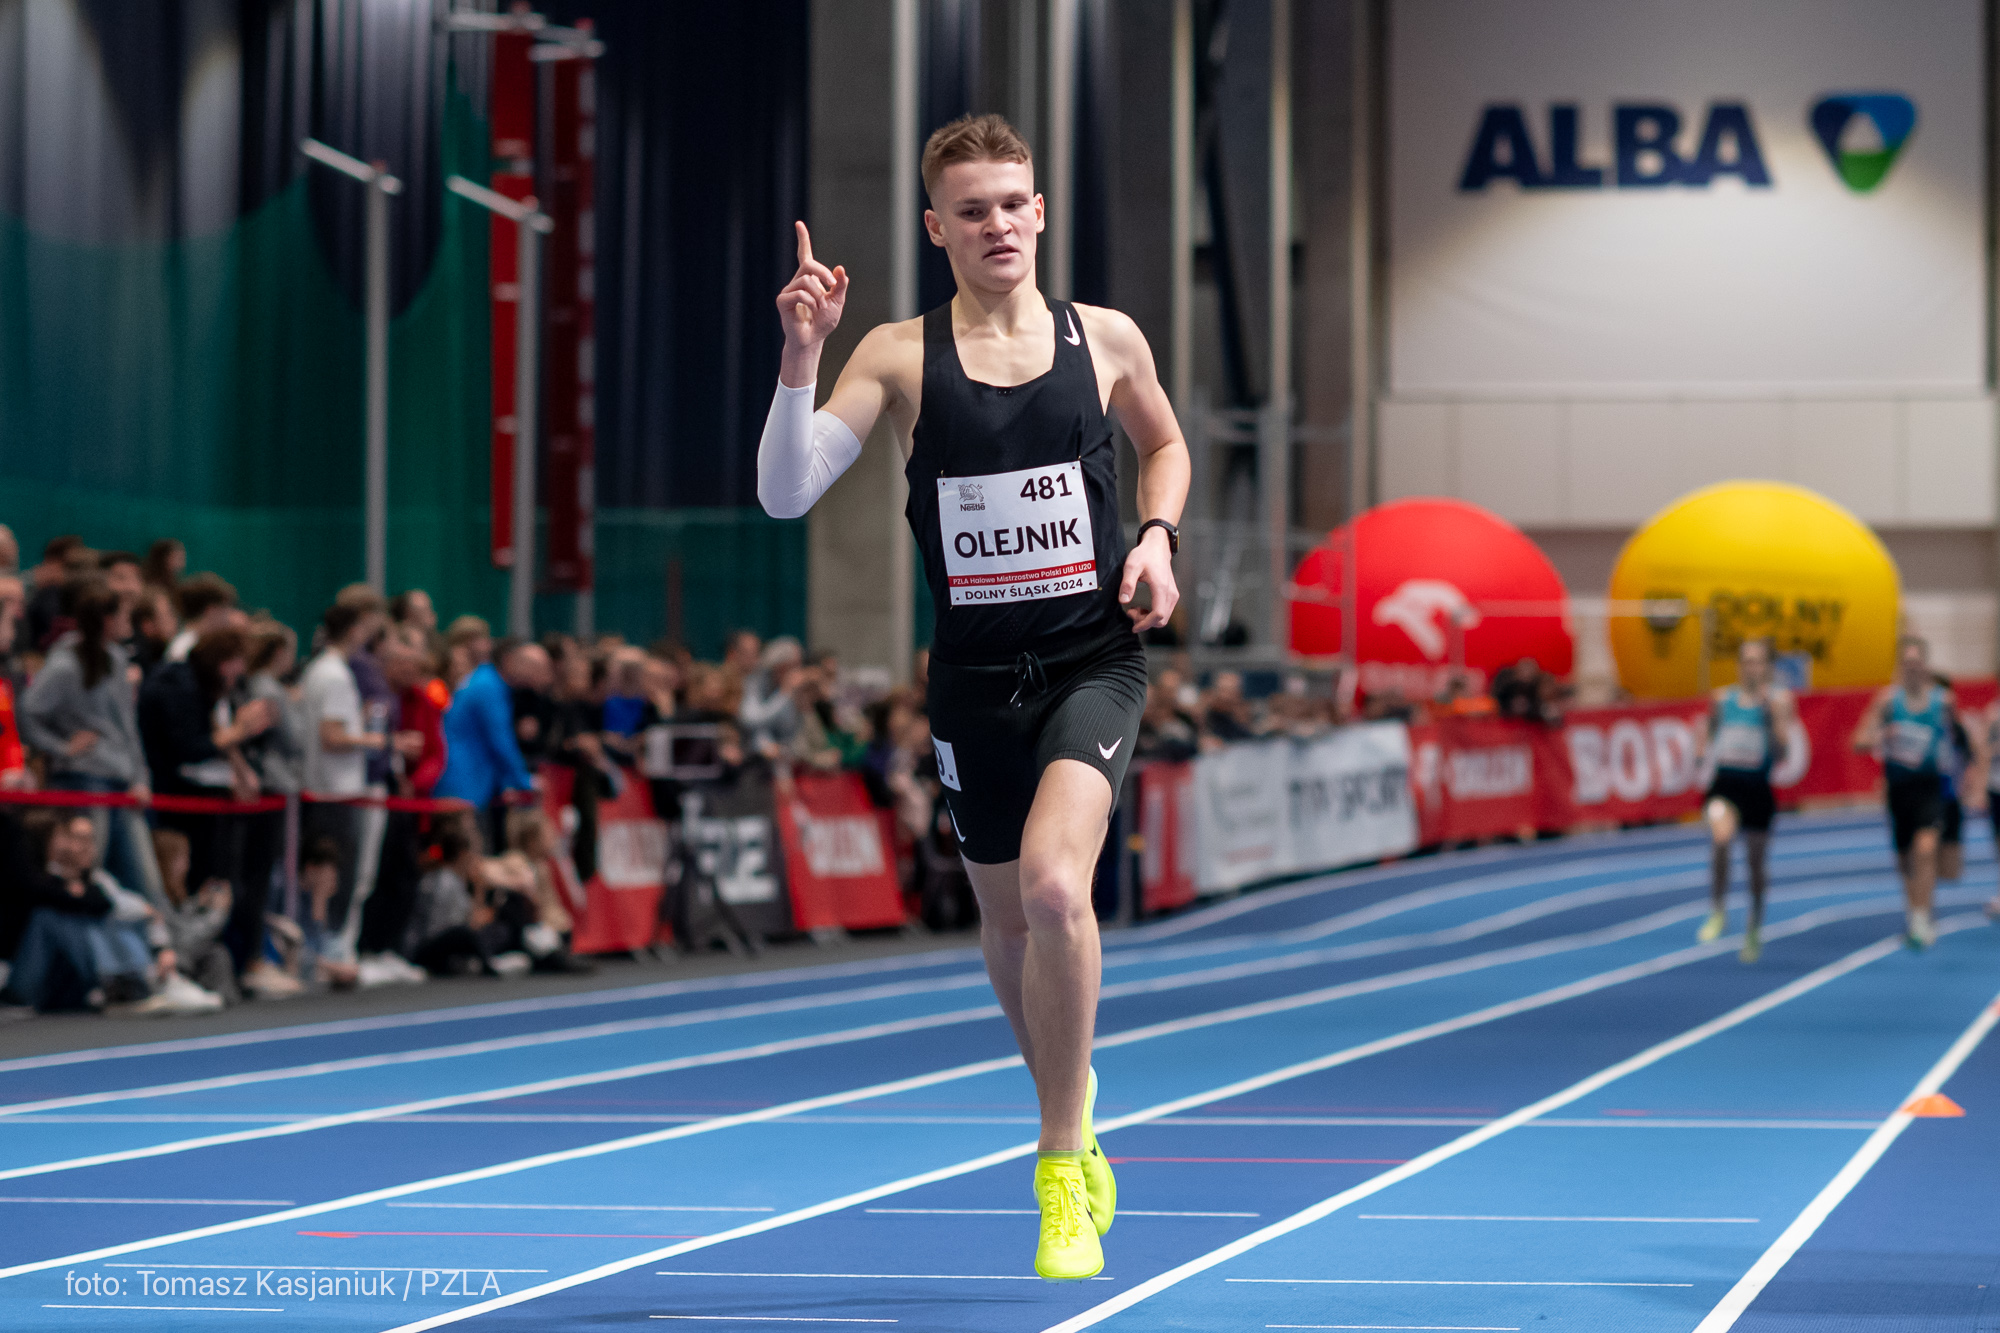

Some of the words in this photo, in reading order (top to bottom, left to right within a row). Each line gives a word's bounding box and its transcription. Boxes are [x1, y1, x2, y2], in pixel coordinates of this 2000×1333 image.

[1459, 102, 1775, 191] ALBA
[1020, 473, 1072, 502] 481
[960, 502, 986, 512] Nestlé
[954, 518, 1082, 559] OLEJNIK
[953, 577, 970, 585] PZLA
[970, 576, 996, 584] Halowe
[996, 572, 1040, 582] Mistrzostwa
[1040, 567, 1062, 578] Polski
[1062, 565, 1075, 575] U18
[1078, 562, 1092, 571] U20
[965, 589, 1006, 600] DOLNY
[1010, 584, 1051, 597] ŚLĄSK
[1053, 578, 1083, 592] 2024
